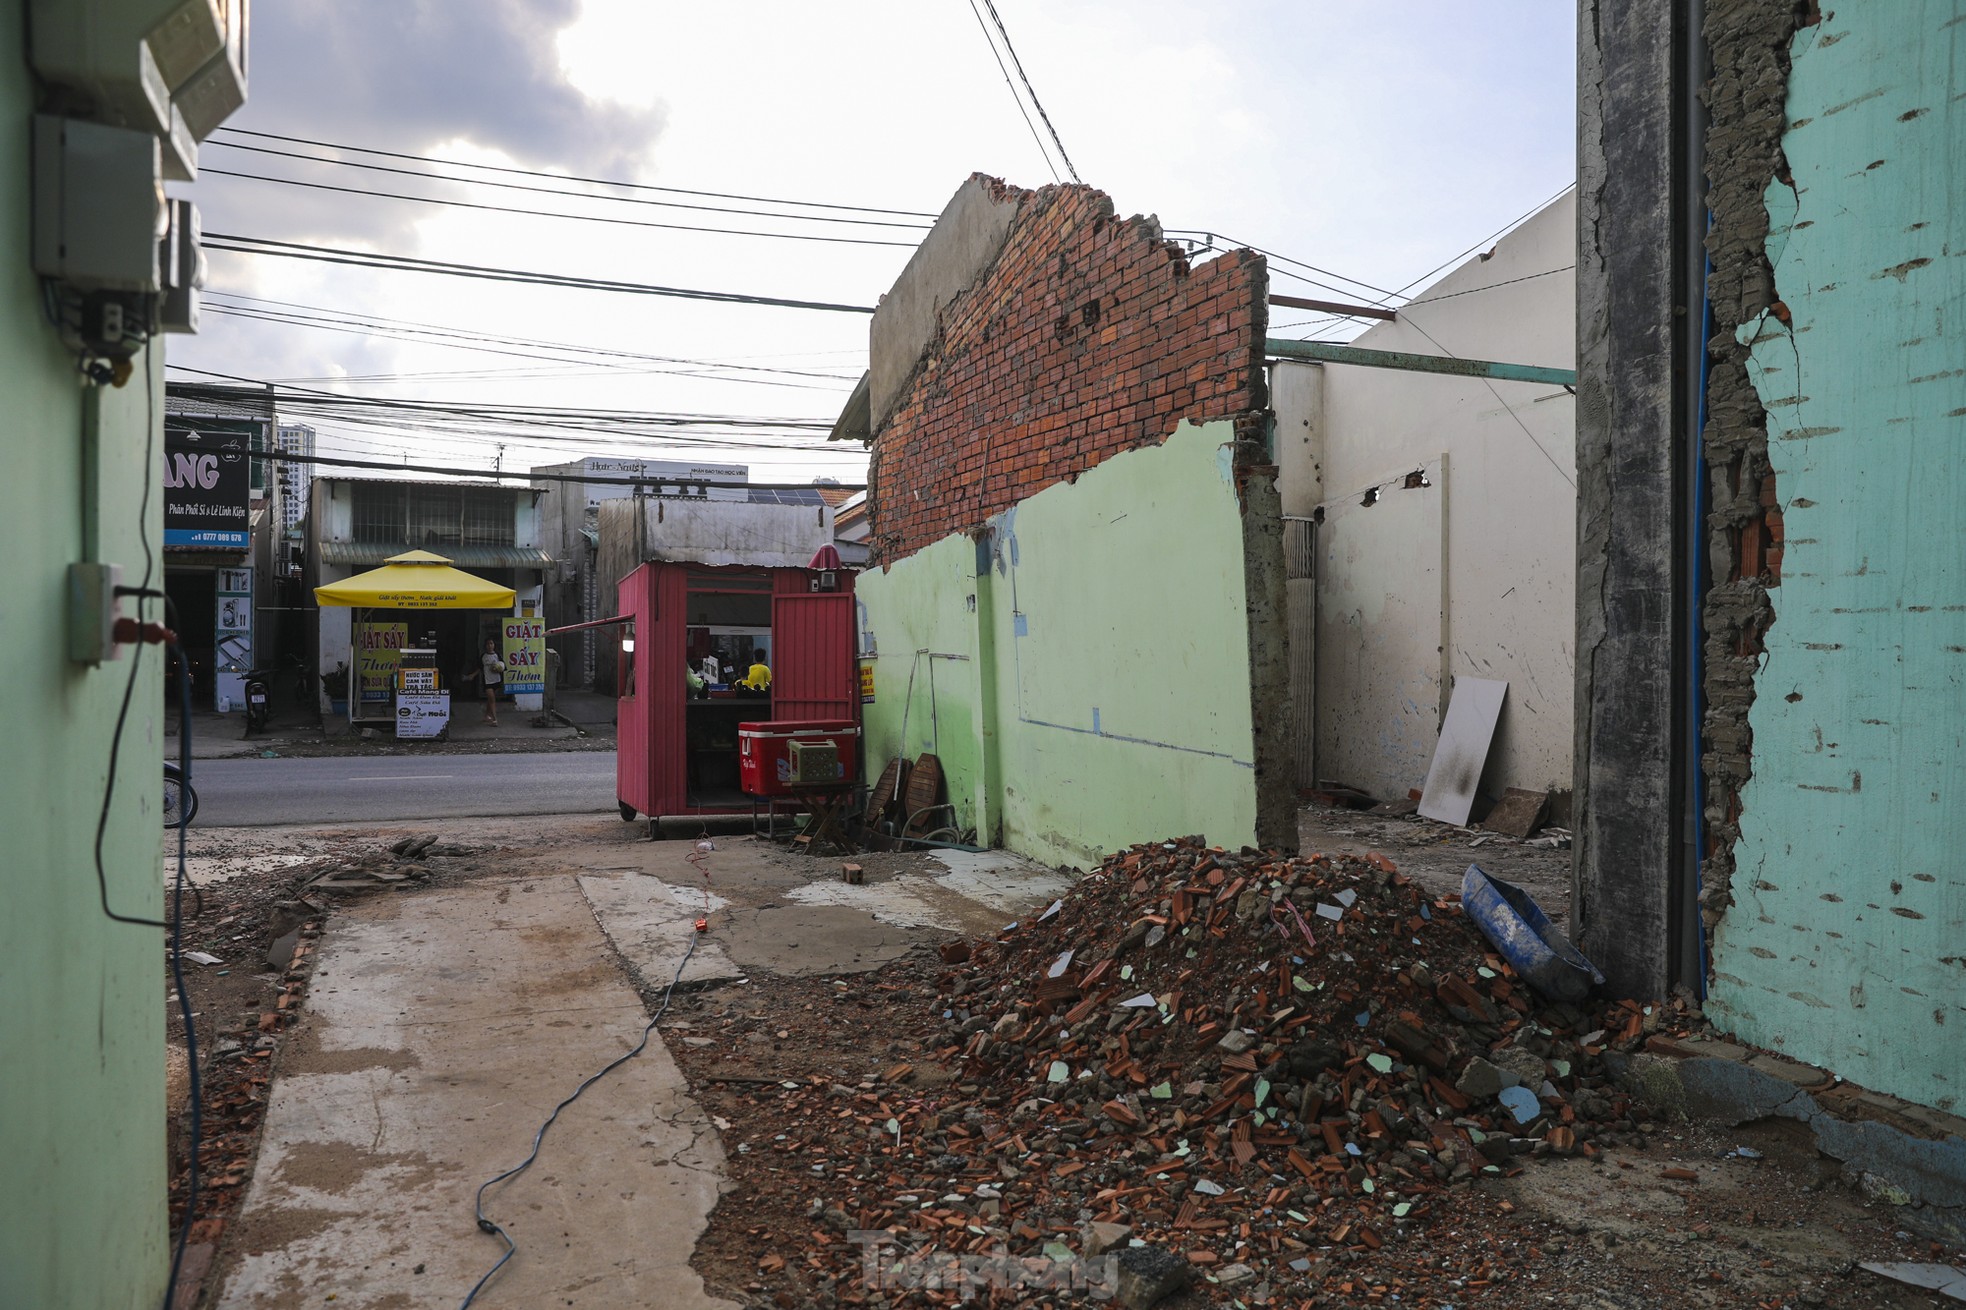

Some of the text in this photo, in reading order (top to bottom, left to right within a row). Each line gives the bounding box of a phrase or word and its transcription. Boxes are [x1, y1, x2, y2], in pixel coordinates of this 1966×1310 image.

[169, 503, 184, 515] Phân
[219, 505, 231, 516] Linh
[232, 506, 245, 519] Kiện
[383, 624, 404, 649] SẤY
[506, 620, 541, 642] GIẶT
[509, 647, 538, 666] SẤY
[506, 670, 541, 681] Thơm
